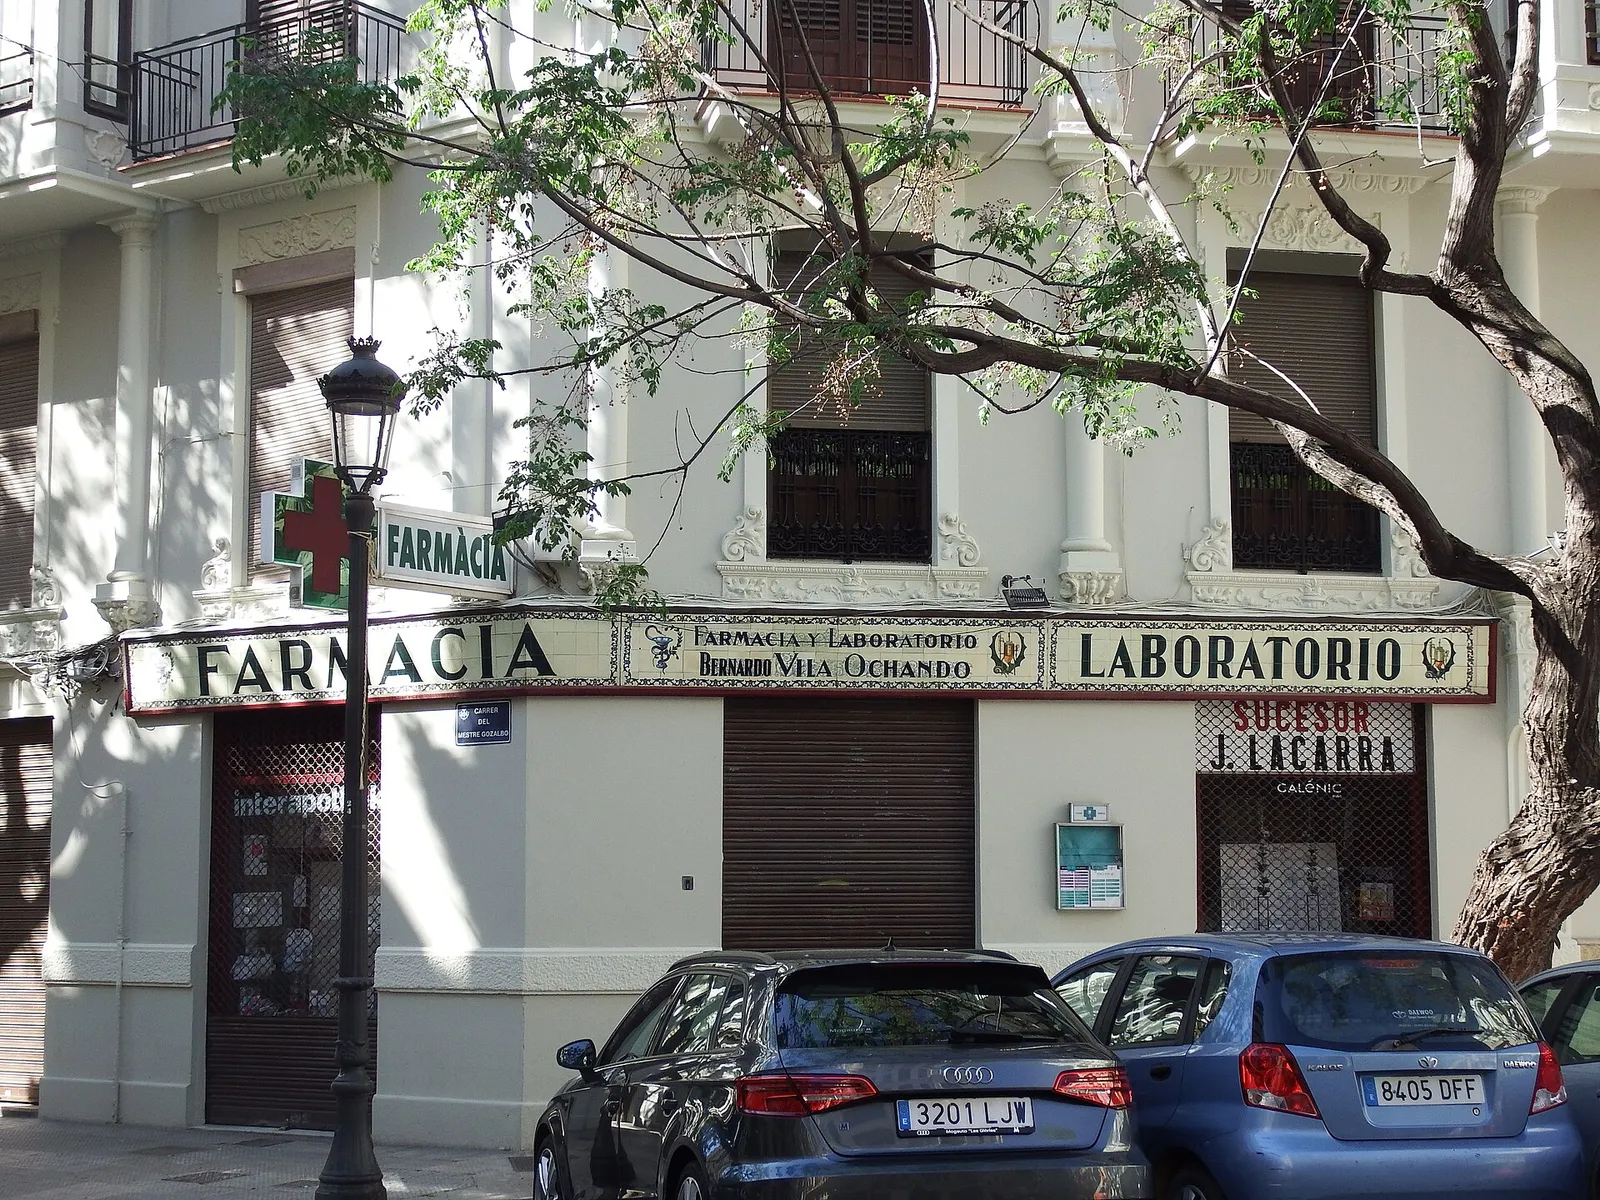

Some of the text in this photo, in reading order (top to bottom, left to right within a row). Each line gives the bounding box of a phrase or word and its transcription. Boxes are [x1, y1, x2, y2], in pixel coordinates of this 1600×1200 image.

[388, 523, 506, 582] FARMÀCIA
[694, 625, 977, 649] FARMACIA Y LABORATORIO
[699, 651, 971, 679] BERNARDO VILA OCHANDO
[1080, 632, 1402, 682] LABORATORIO
[474, 706, 499, 715] CARRER
[477, 718, 491, 726] DEL
[1233, 700, 1369, 733] SUCESOR
[458, 729, 509, 739] MESTRE GOZALBO
[1210, 733, 1395, 772] J. LACARRA
[1503, 1060, 1538, 1069] DAEWOO
[1381, 1078, 1475, 1101] 8405 DFF
[902, 1117, 908, 1125] E
[916, 1101, 1026, 1125] 3201 LJW
